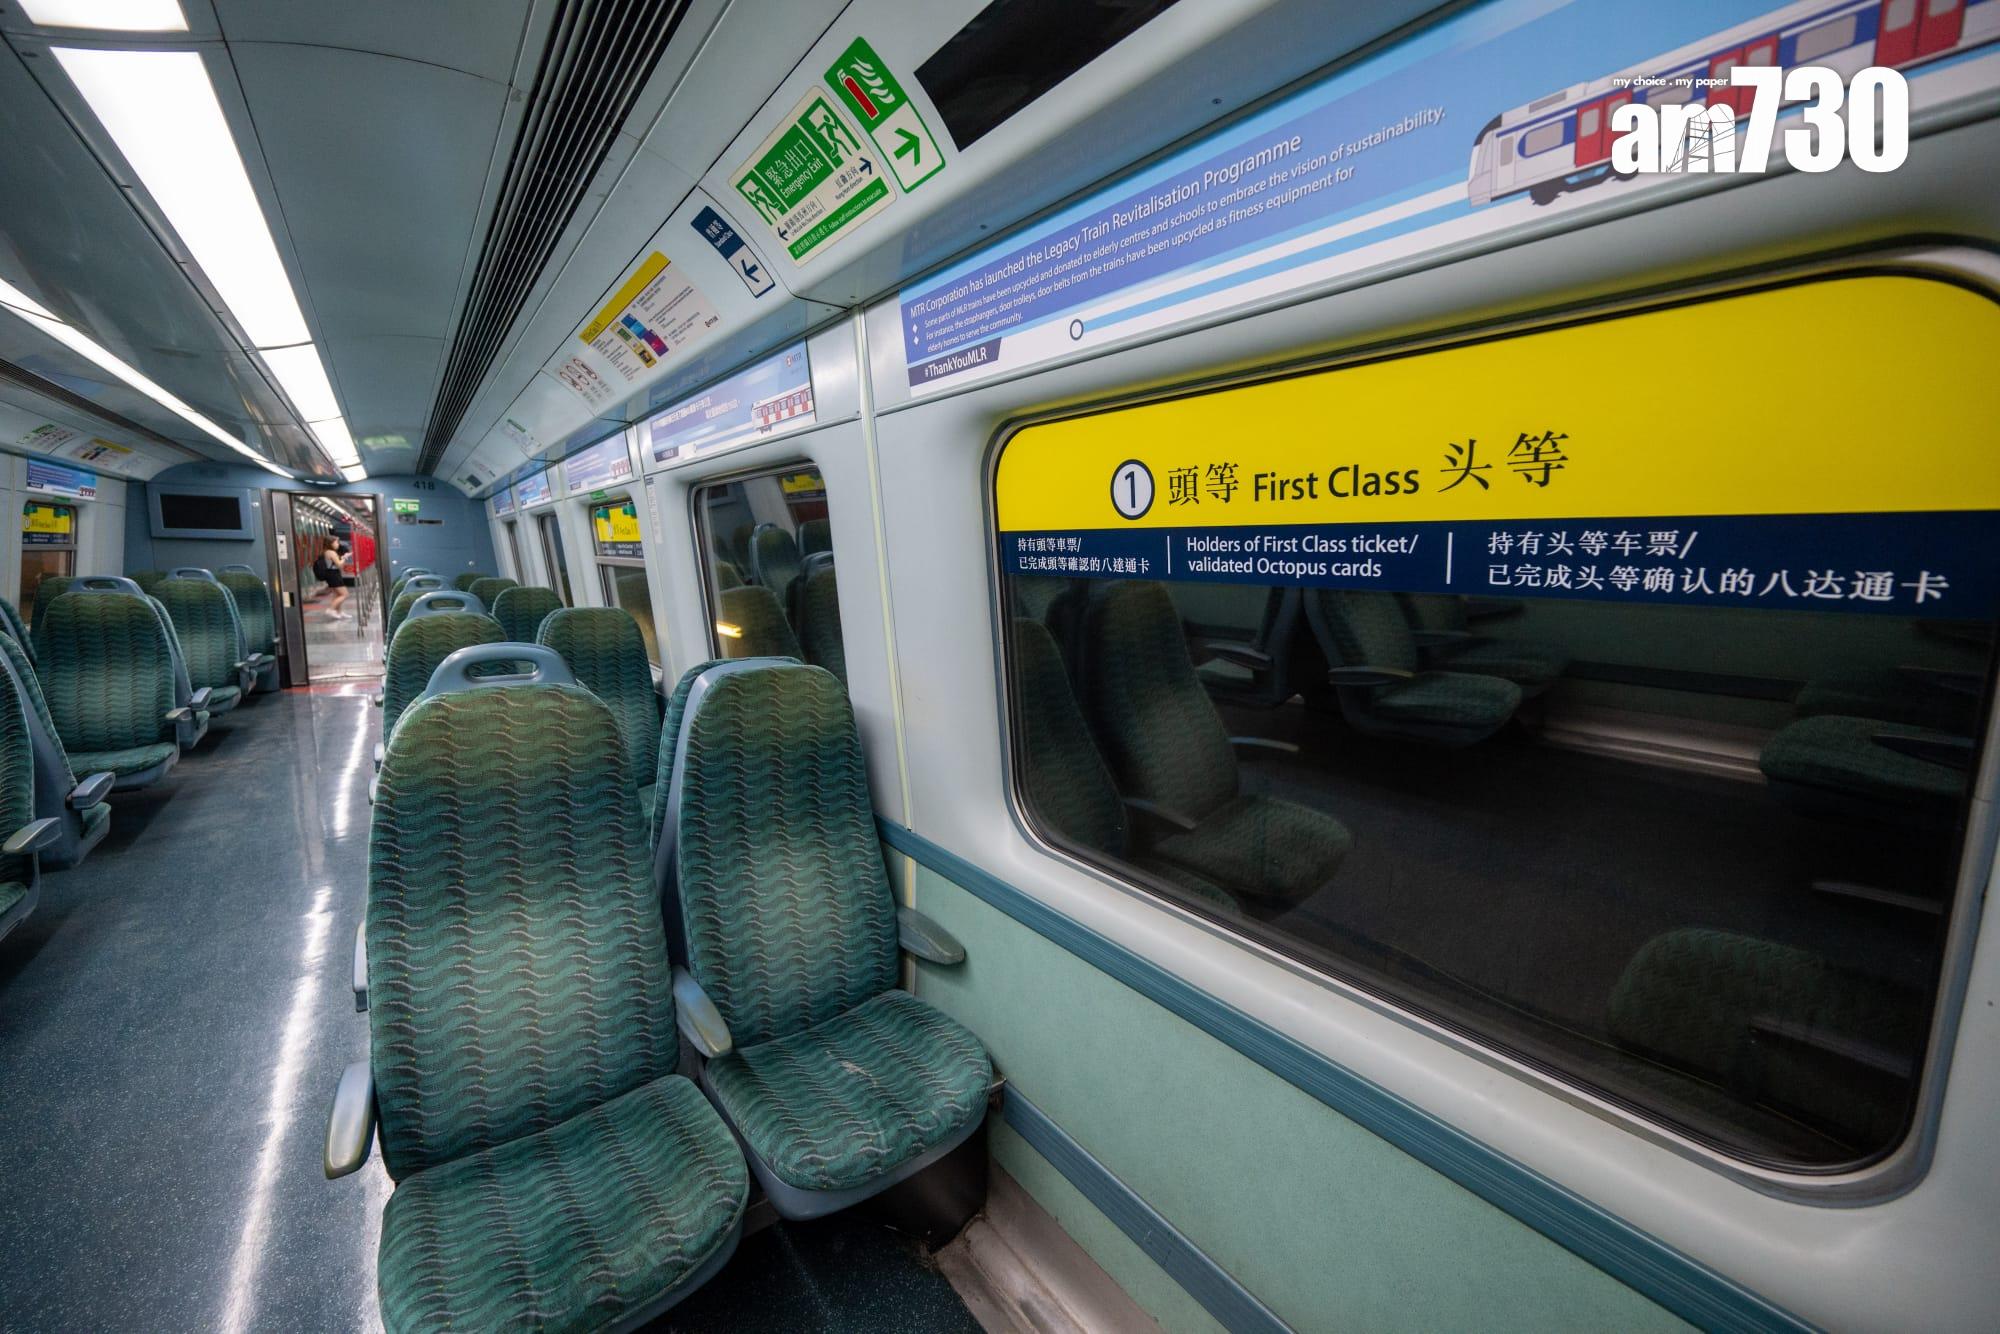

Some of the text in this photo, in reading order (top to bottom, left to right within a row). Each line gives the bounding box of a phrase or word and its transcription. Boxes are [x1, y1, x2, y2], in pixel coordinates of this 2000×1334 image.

[765, 139, 813, 187] 緊急出口
[780, 170, 813, 199] Emergency
[807, 156, 824, 174] Exit
[910, 135, 1302, 319] MTR Corporation has launched the Legacy Train Revitalisation Programme
[924, 317, 938, 329] Some
[938, 311, 951, 327] parts
[956, 305, 968, 316] MLR
[967, 298, 983, 313] trains
[982, 293, 997, 306] have
[997, 286, 1012, 300] been
[1012, 274, 1040, 295] upcycled
[1039, 265, 1053, 281] and
[1053, 254, 1083, 276] donated
[1083, 250, 1092, 262] to
[1093, 239, 1119, 259] elderly
[1120, 229, 1151, 249] centres
[1151, 219, 1169, 236] and
[1170, 204, 1206, 228] schools
[1207, 200, 1218, 213] to
[1219, 179, 1267, 208] embrace
[1268, 169, 1289, 187] the
[1291, 153, 1327, 178] vision
[1329, 143, 1344, 163] of
[1346, 106, 1446, 156] sustainability.
[926, 329, 935, 341] For
[954, 319, 964, 330] the
[999, 299, 1014, 313] door
[1013, 291, 1037, 308] trolleys,
[1037, 284, 1052, 299] door
[1053, 277, 1072, 292] belts
[1071, 269, 1089, 286] from
[1089, 264, 1103, 278] the
[1103, 255, 1126, 273] trains
[1125, 249, 1146, 265] have
[1147, 239, 1170, 256] been
[1171, 219, 1214, 247] upcycled
[1216, 216, 1227, 230] as
[1229, 202, 1264, 224] fitness
[1266, 172, 1333, 209] equipment
[1335, 165, 1355, 183] for
[942, 336, 959, 349] homes
[966, 329, 980, 342] serve
[980, 324, 990, 335] the
[989, 311, 1024, 331] community.
[924, 346, 988, 379] #ThankYouMLR
[1436, 430, 1570, 493] 头等
[413, 480, 435, 490] 418
[1167, 461, 1240, 507] 頭等
[1253, 463, 1420, 503] First Class
[1017, 537, 1082, 553] 持有頭等車票/
[1186, 533, 1420, 556] Holders of First Class ticket/
[1487, 529, 1699, 559] 持有头等车票/
[1018, 556, 1150, 574] 已完成頭等確認的八達通卡
[1188, 557, 1382, 579] validated Octopus cards
[1487, 563, 1951, 605] 已完成头等确认的八达通卡
